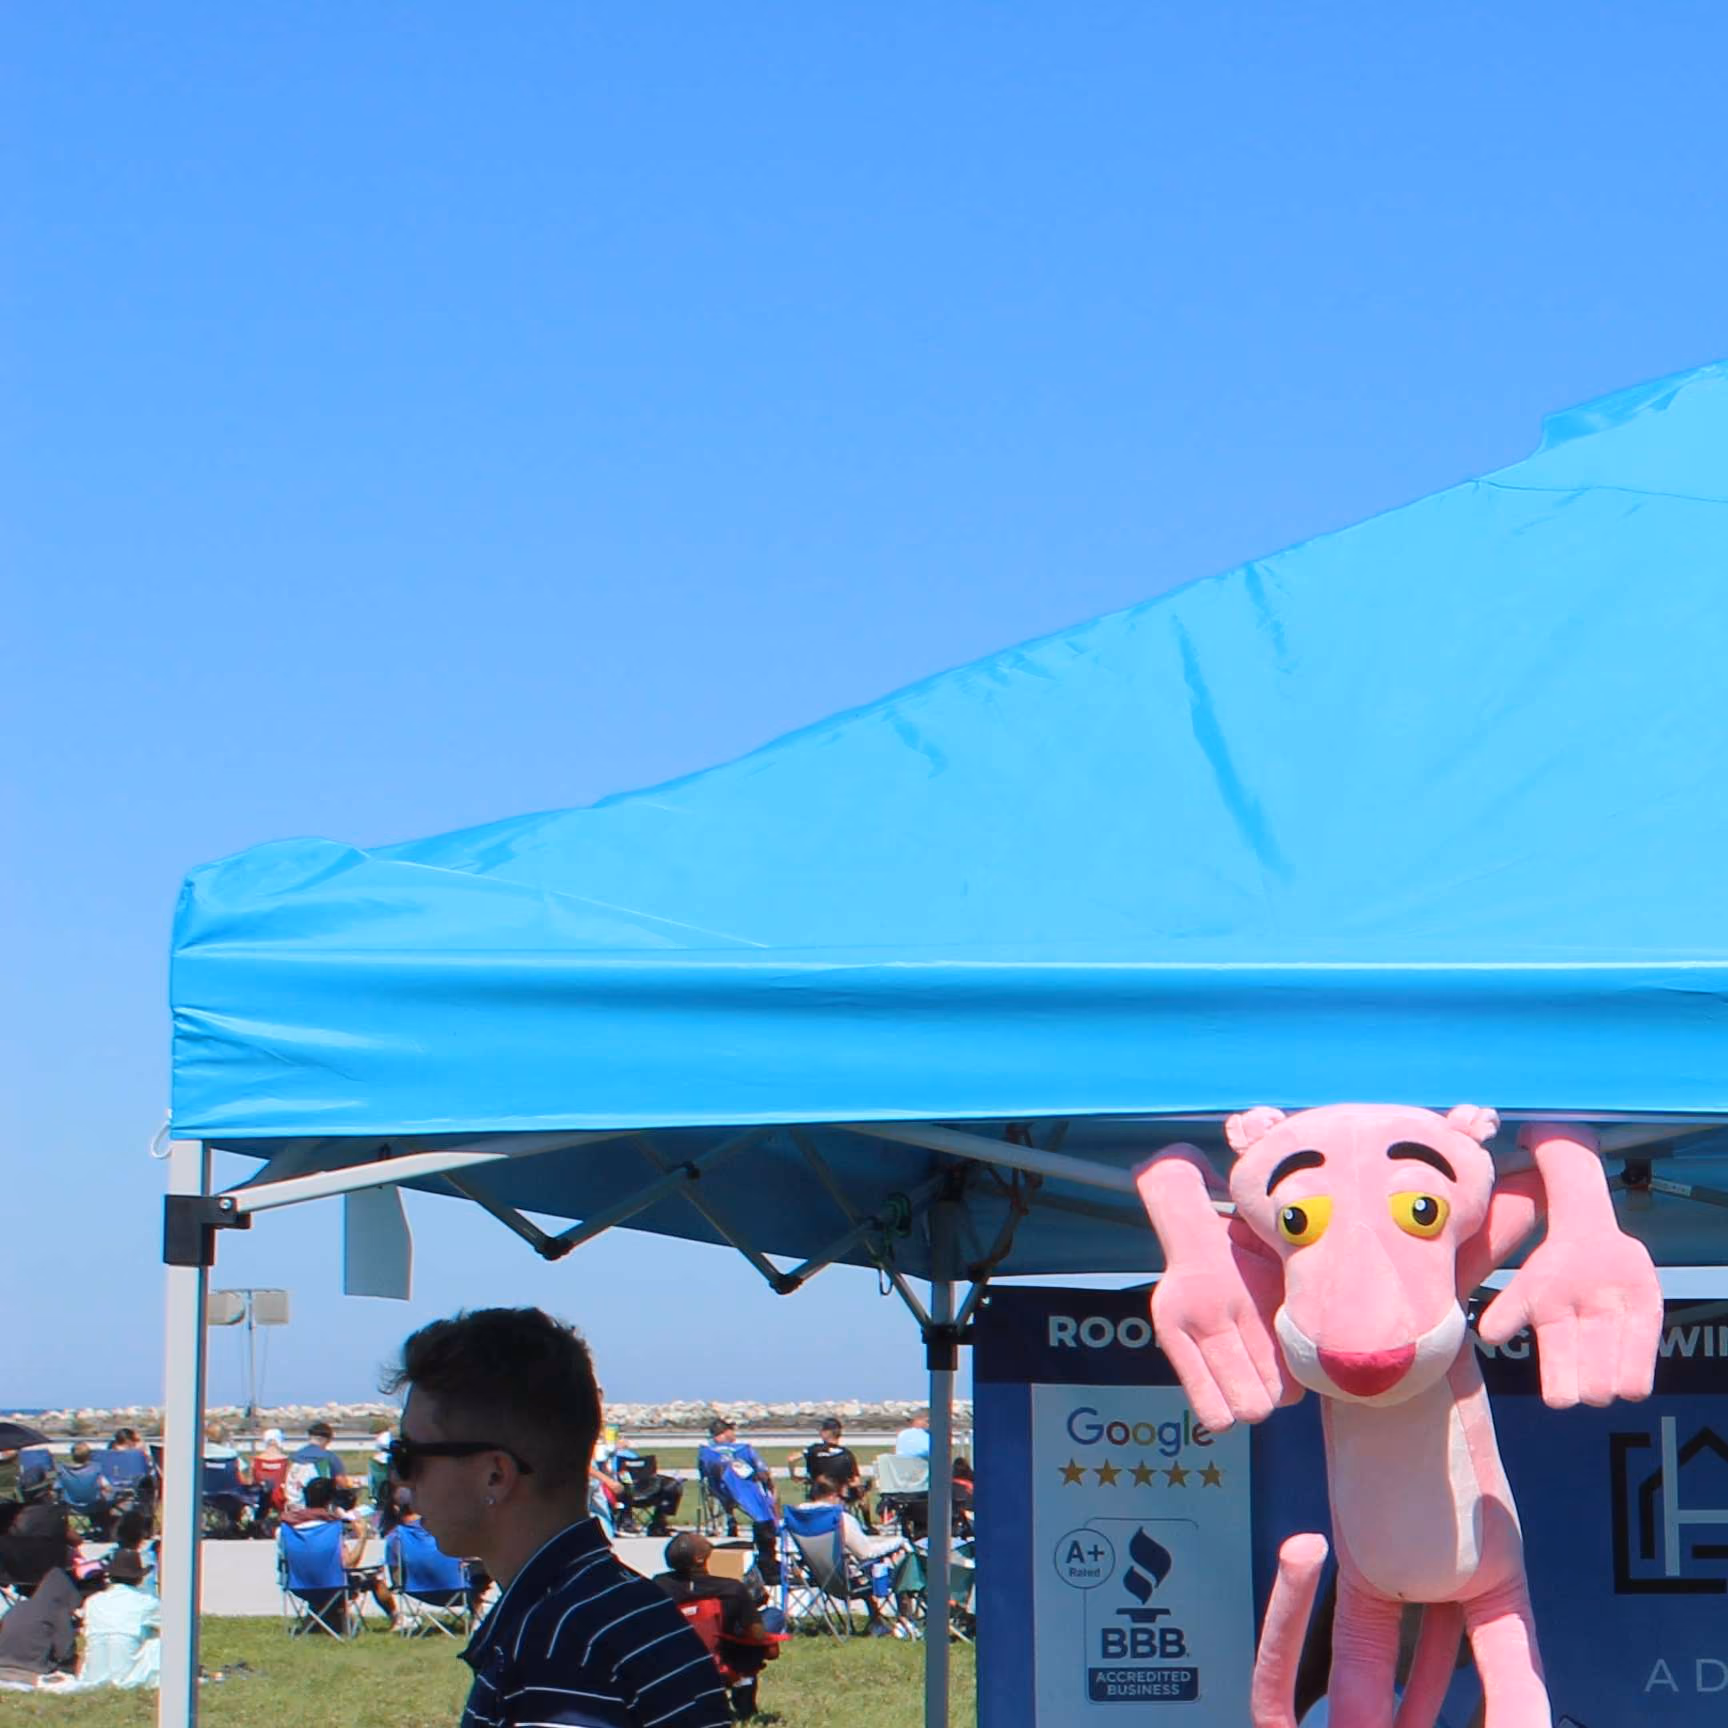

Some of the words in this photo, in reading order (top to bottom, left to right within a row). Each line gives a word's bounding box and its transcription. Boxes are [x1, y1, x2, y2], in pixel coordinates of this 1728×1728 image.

[1048, 1316, 1163, 1348] ROO
[1066, 1406, 1215, 1458] Google
[1064, 1542, 1105, 1564] A+
[1068, 1566, 1103, 1578] Rated
[1101, 1627, 1187, 1660] BBB
[1095, 1670, 1193, 1686] ACCREDITED
[1643, 1657, 1680, 1694] A
[1106, 1683, 1181, 1698] BUSINESS
